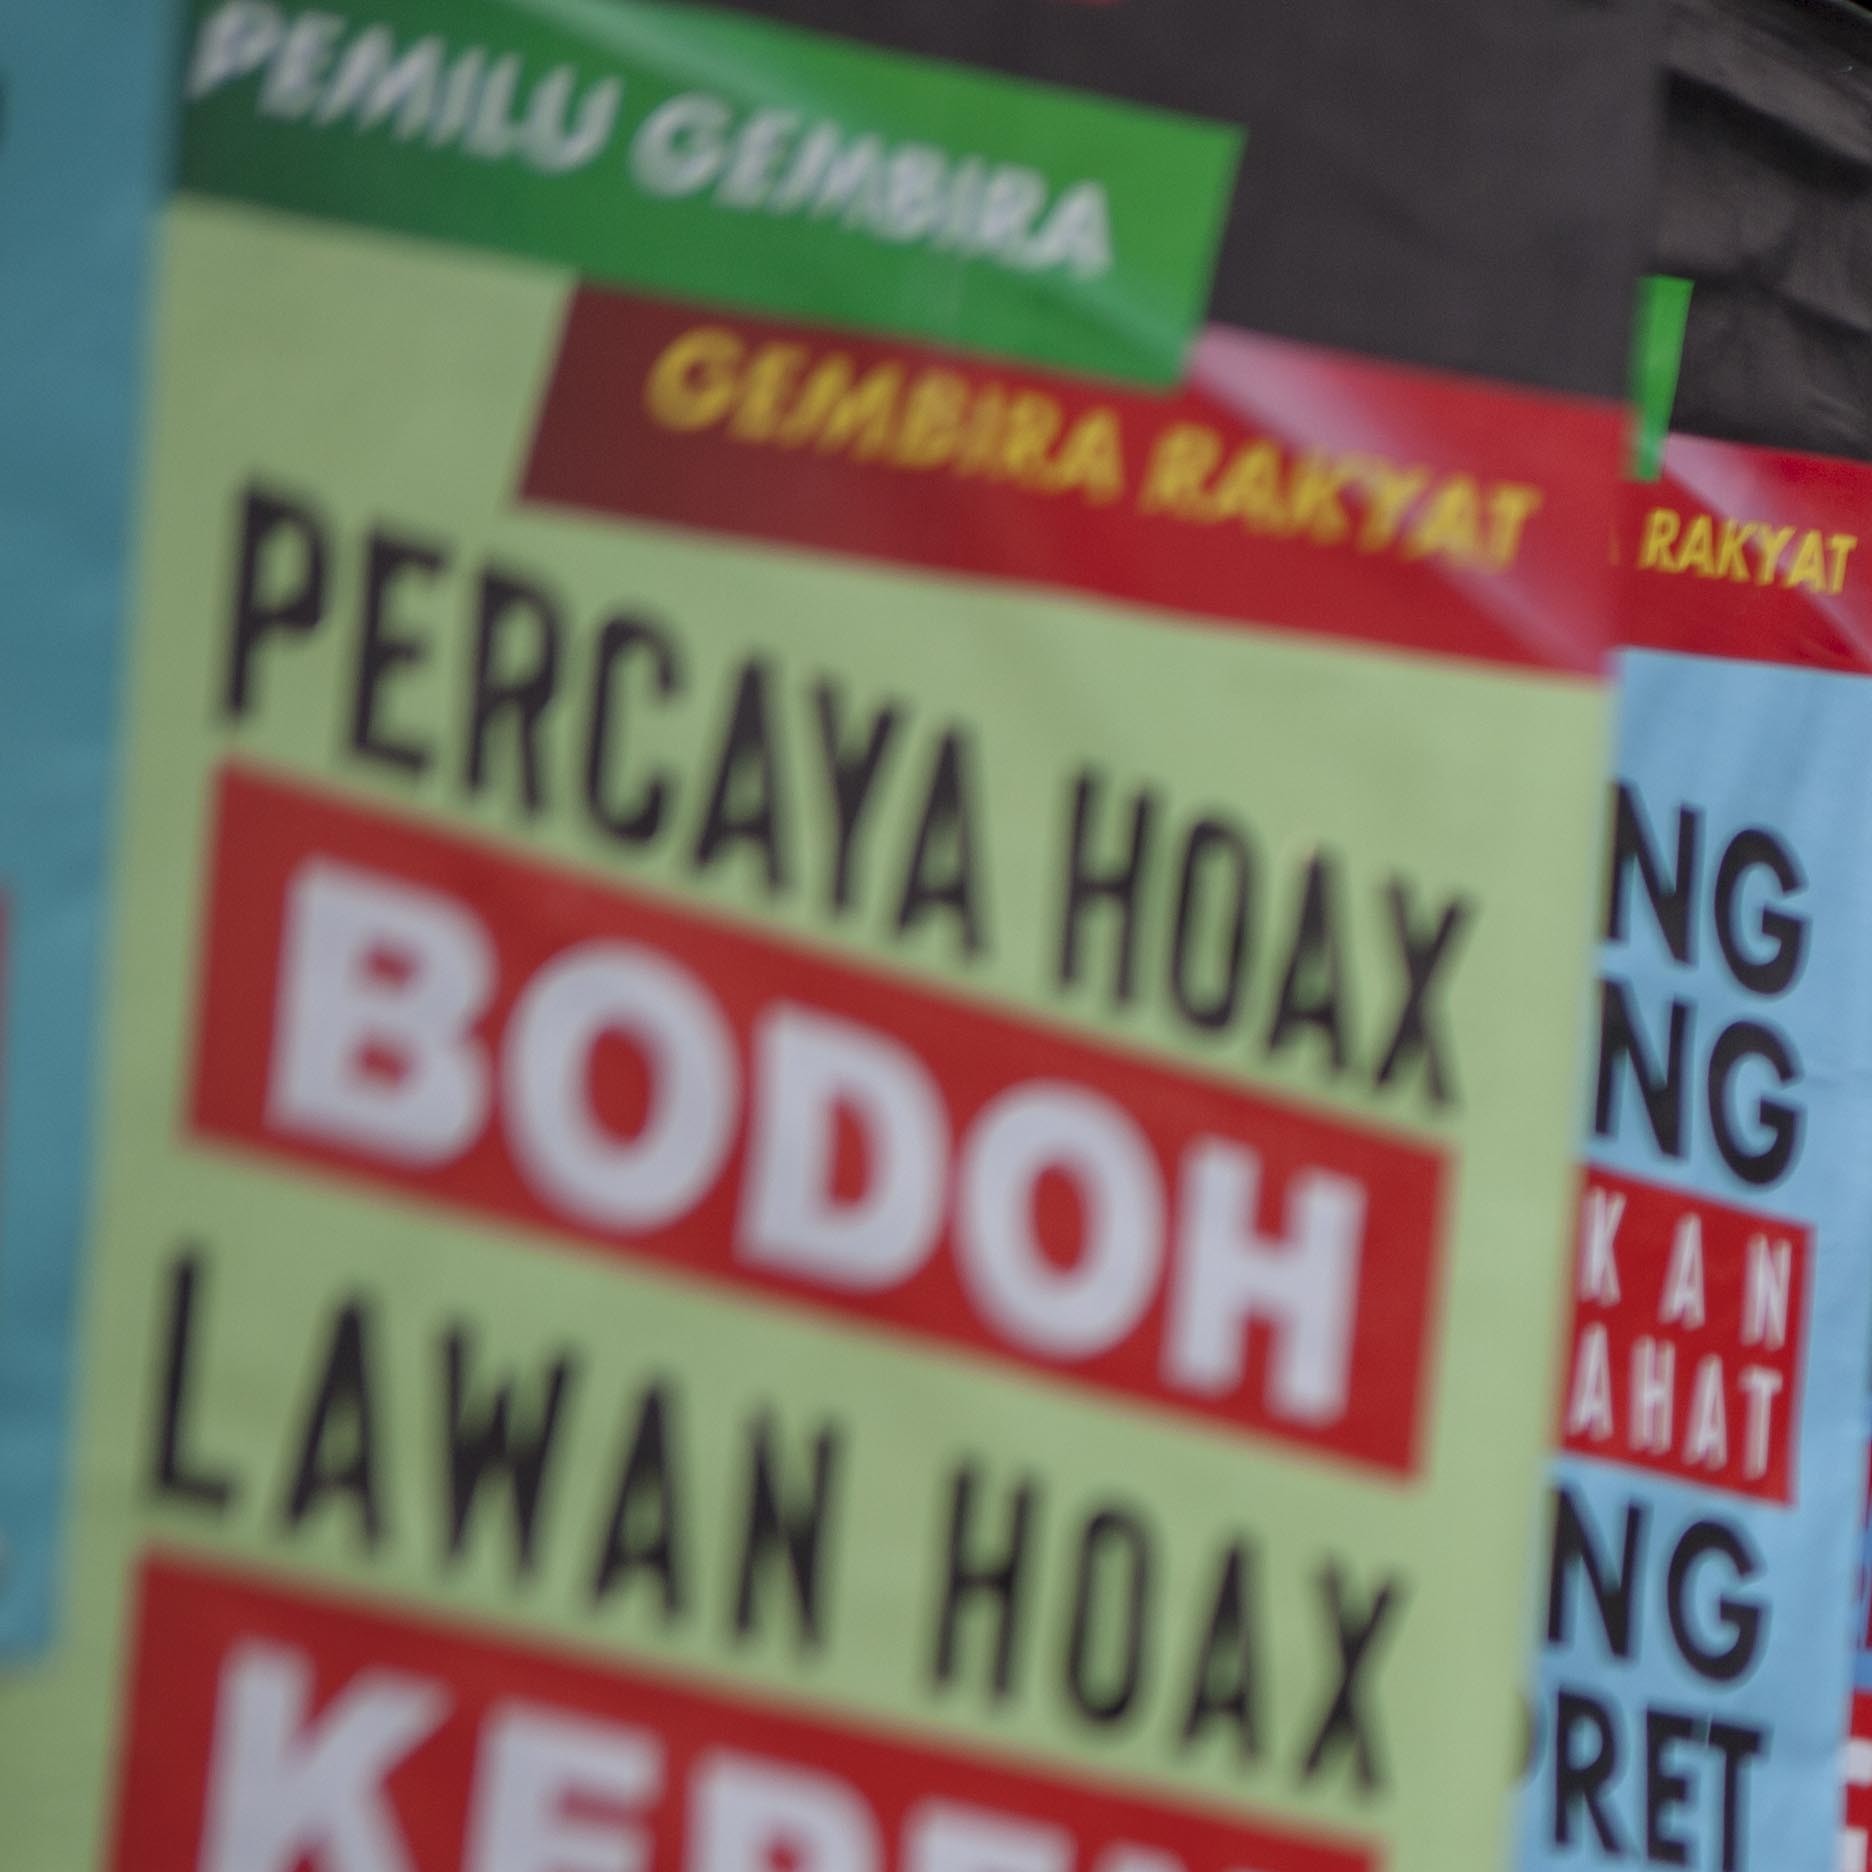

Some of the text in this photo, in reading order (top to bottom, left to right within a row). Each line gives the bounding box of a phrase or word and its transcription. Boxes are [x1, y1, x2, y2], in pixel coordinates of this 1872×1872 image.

[186, 2, 1113, 281] PEMILU GEMBIRA
[648, 328, 1541, 573] GEMBIRA RAKYAT
[1638, 508, 1857, 595] RAKYAT
[215, 475, 1477, 1112] PERCAYA HOAX
[266, 856, 1368, 1430] BODOH
[143, 1241, 1408, 1800] LAWAN HOAX
